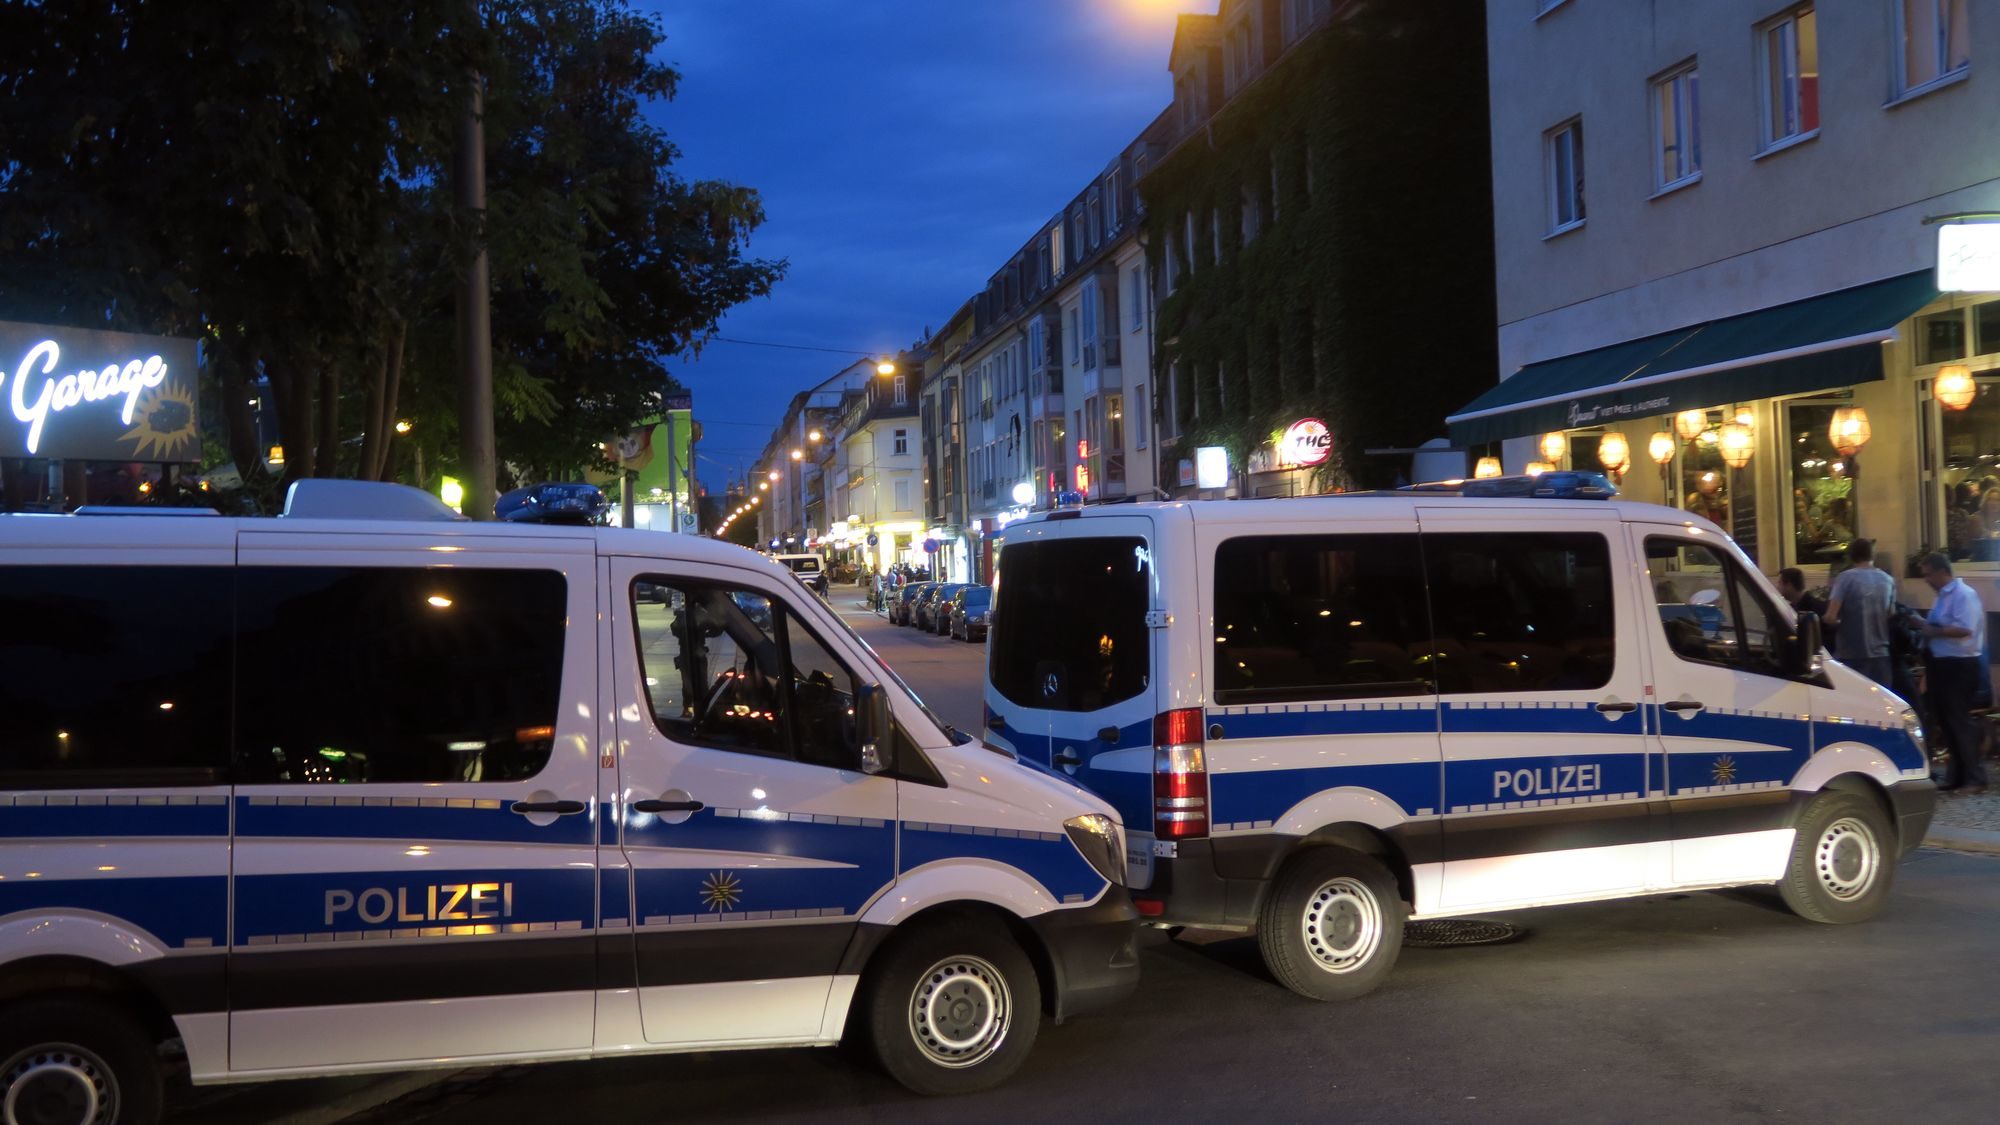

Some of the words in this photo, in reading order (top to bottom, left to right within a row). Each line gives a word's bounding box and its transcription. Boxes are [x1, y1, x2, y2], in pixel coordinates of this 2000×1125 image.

[11, 340, 167, 454] Garage
[1493, 764, 1600, 798] POLIZEI
[325, 882, 512, 925] POLIZEI
